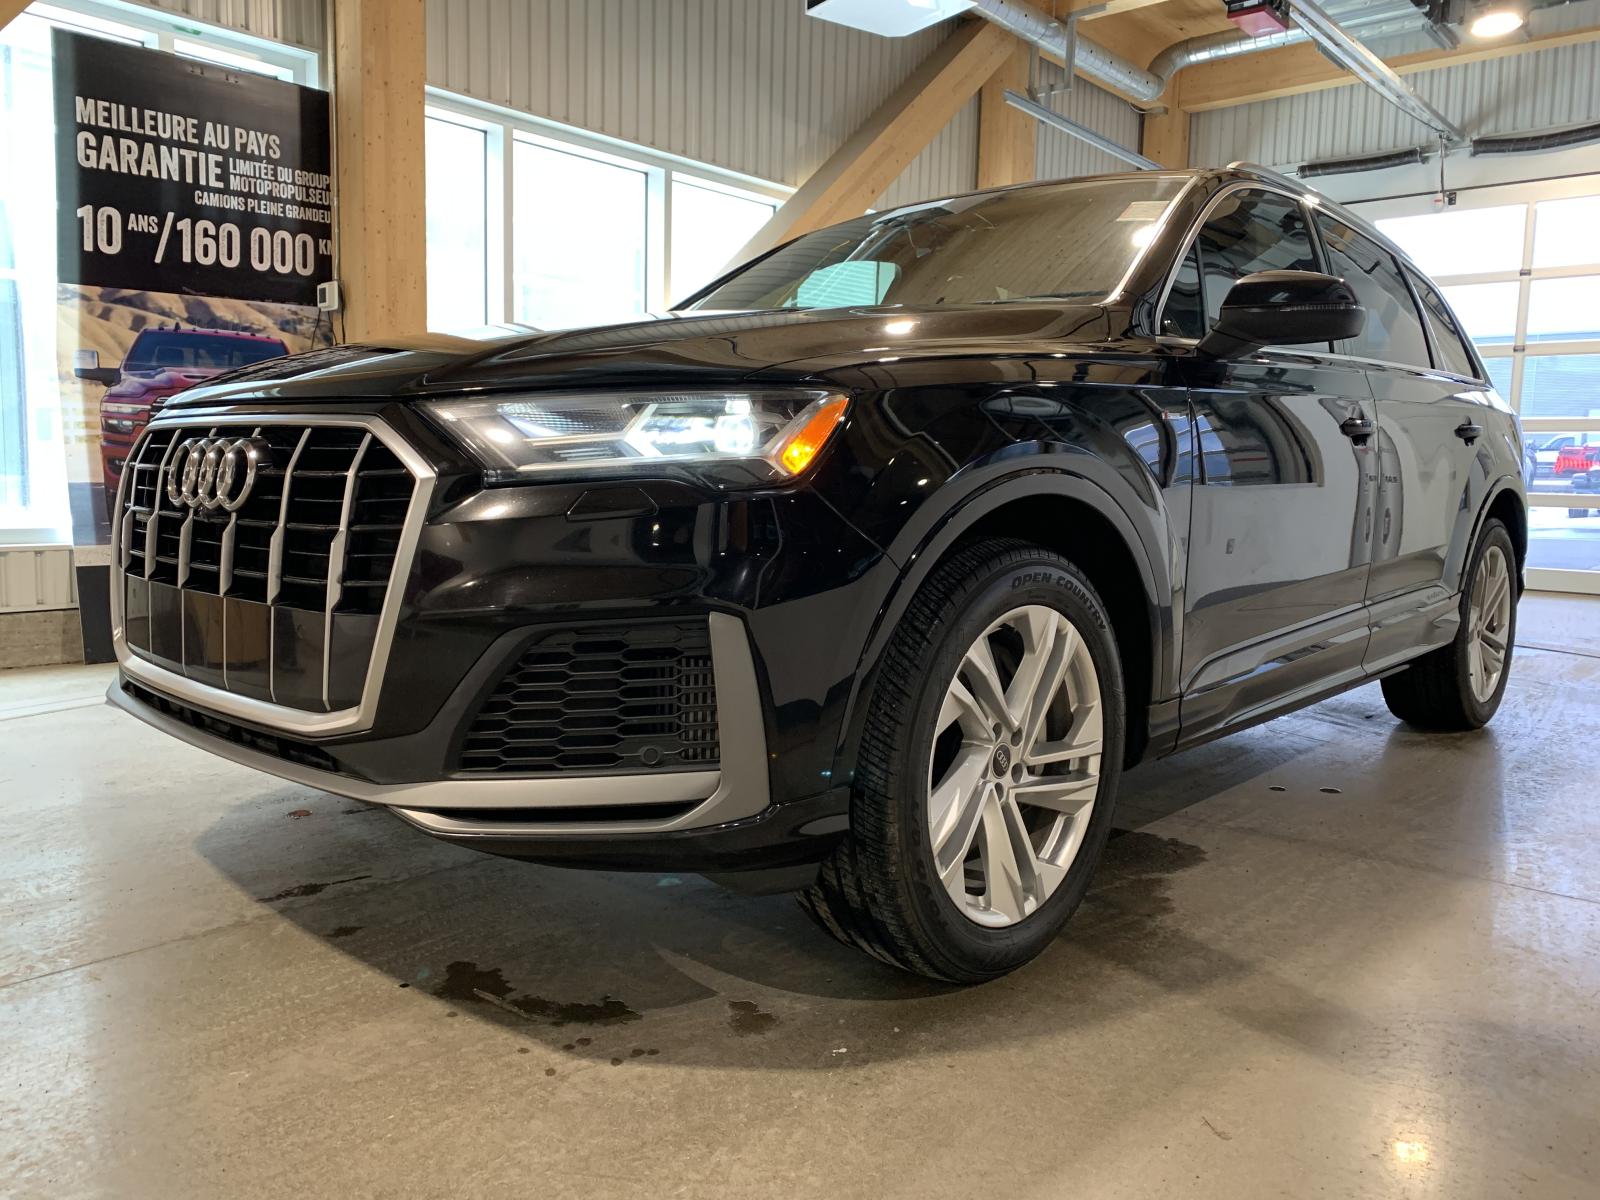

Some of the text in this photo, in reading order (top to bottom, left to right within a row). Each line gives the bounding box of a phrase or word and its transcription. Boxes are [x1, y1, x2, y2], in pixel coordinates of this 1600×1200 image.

[75, 95, 281, 160] MEILLEURE AU PAYS
[76, 131, 224, 189] GARANTIE
[229, 157, 330, 190] LIMITÉE DU GROUP
[194, 190, 331, 224] CAMIONS PLEINE GRANDEU
[229, 174, 331, 206] MOTOPROPULSEU
[76, 204, 122, 255] 10
[127, 213, 159, 234] ANS
[250, 227, 315, 277] 000
[1011, 571, 1107, 630] OPEN COUNTRY
